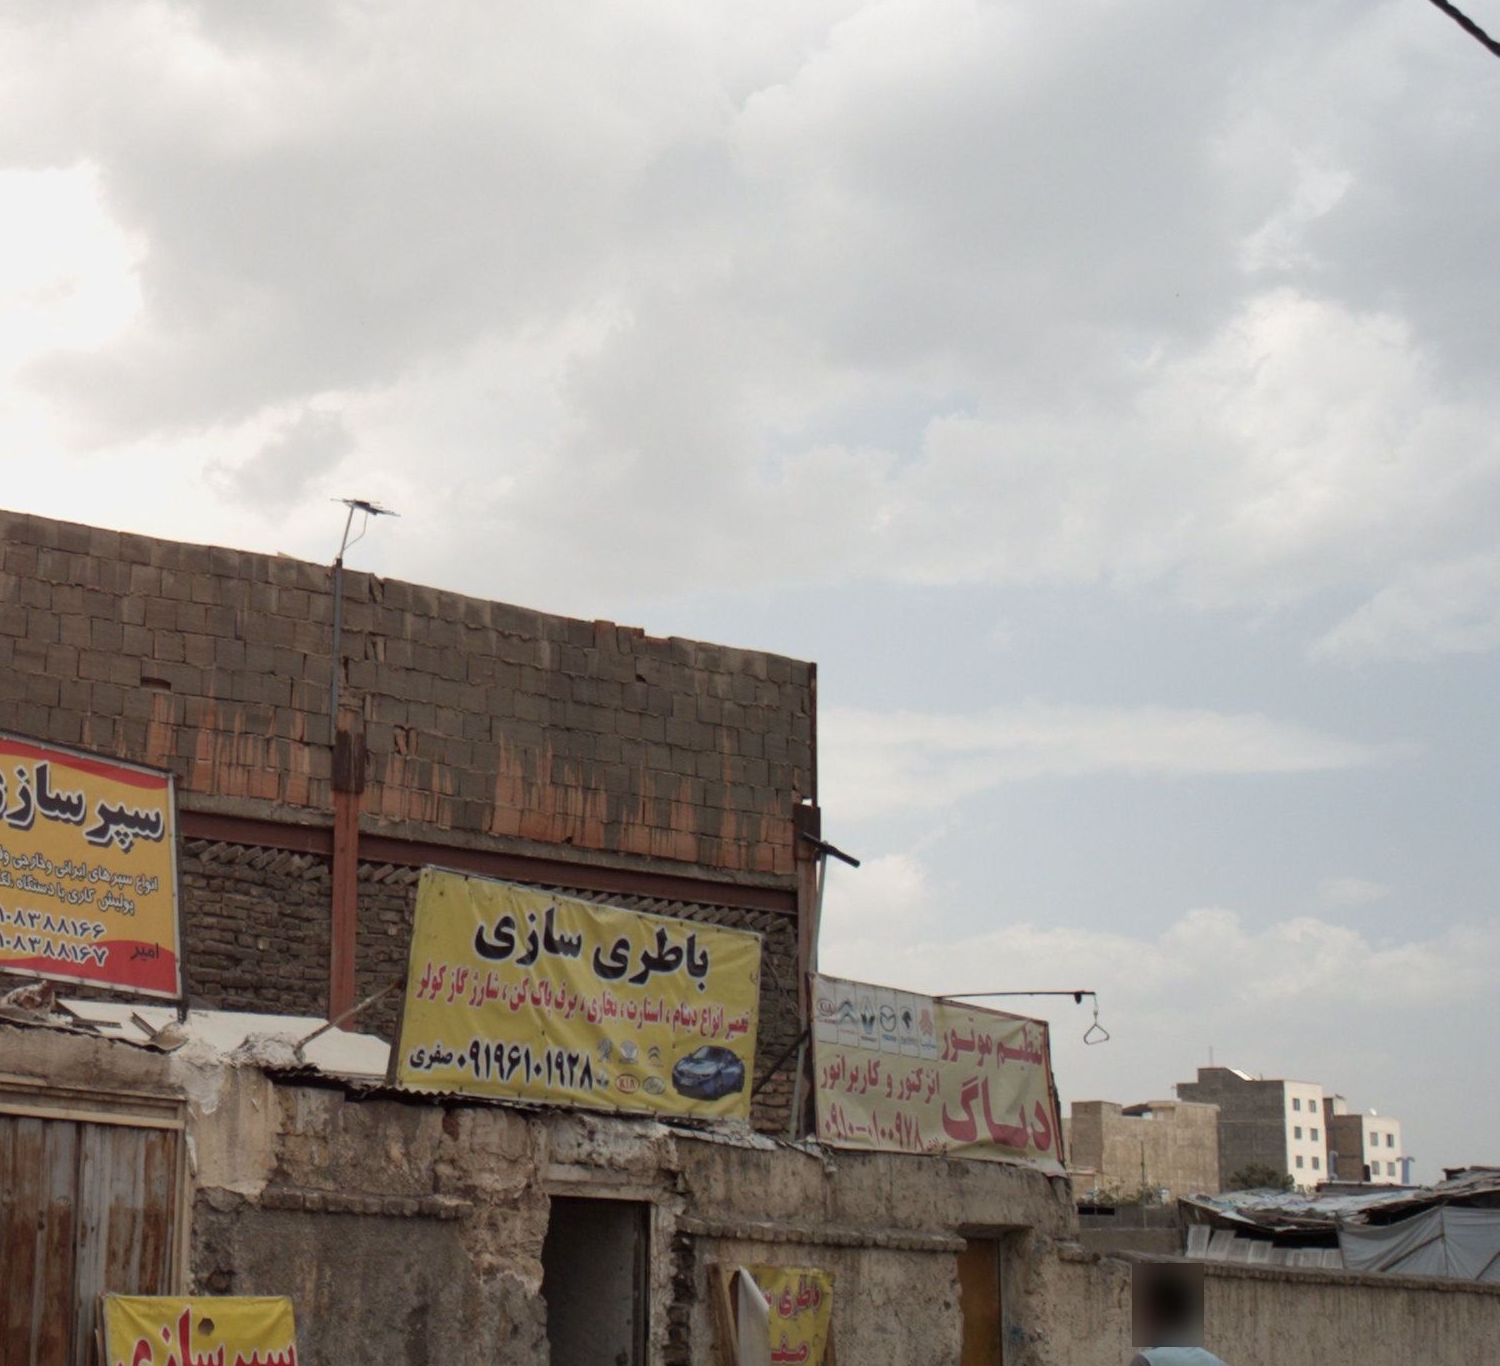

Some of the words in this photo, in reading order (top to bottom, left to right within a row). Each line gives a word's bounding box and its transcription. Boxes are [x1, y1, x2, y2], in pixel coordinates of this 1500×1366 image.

[55, 860, 87, 882] ایرانی
[15, 874, 55, 897] دستگاه
[56, 882, 66, 904] با
[68, 886, 96, 906] کاری
[135, 873, 159, 895] انواع
[97, 891, 135, 916] پولیش
[474, 906, 583, 966] سازی
[130, 942, 160, 961] امیر
[592, 927, 710, 991] باطری
[941, 1017, 993, 1067] موتور
[996, 1025, 1044, 1069] تنظیم
[409, 1044, 453, 1072] صفری
[772, 1333, 809, 1365] صف
